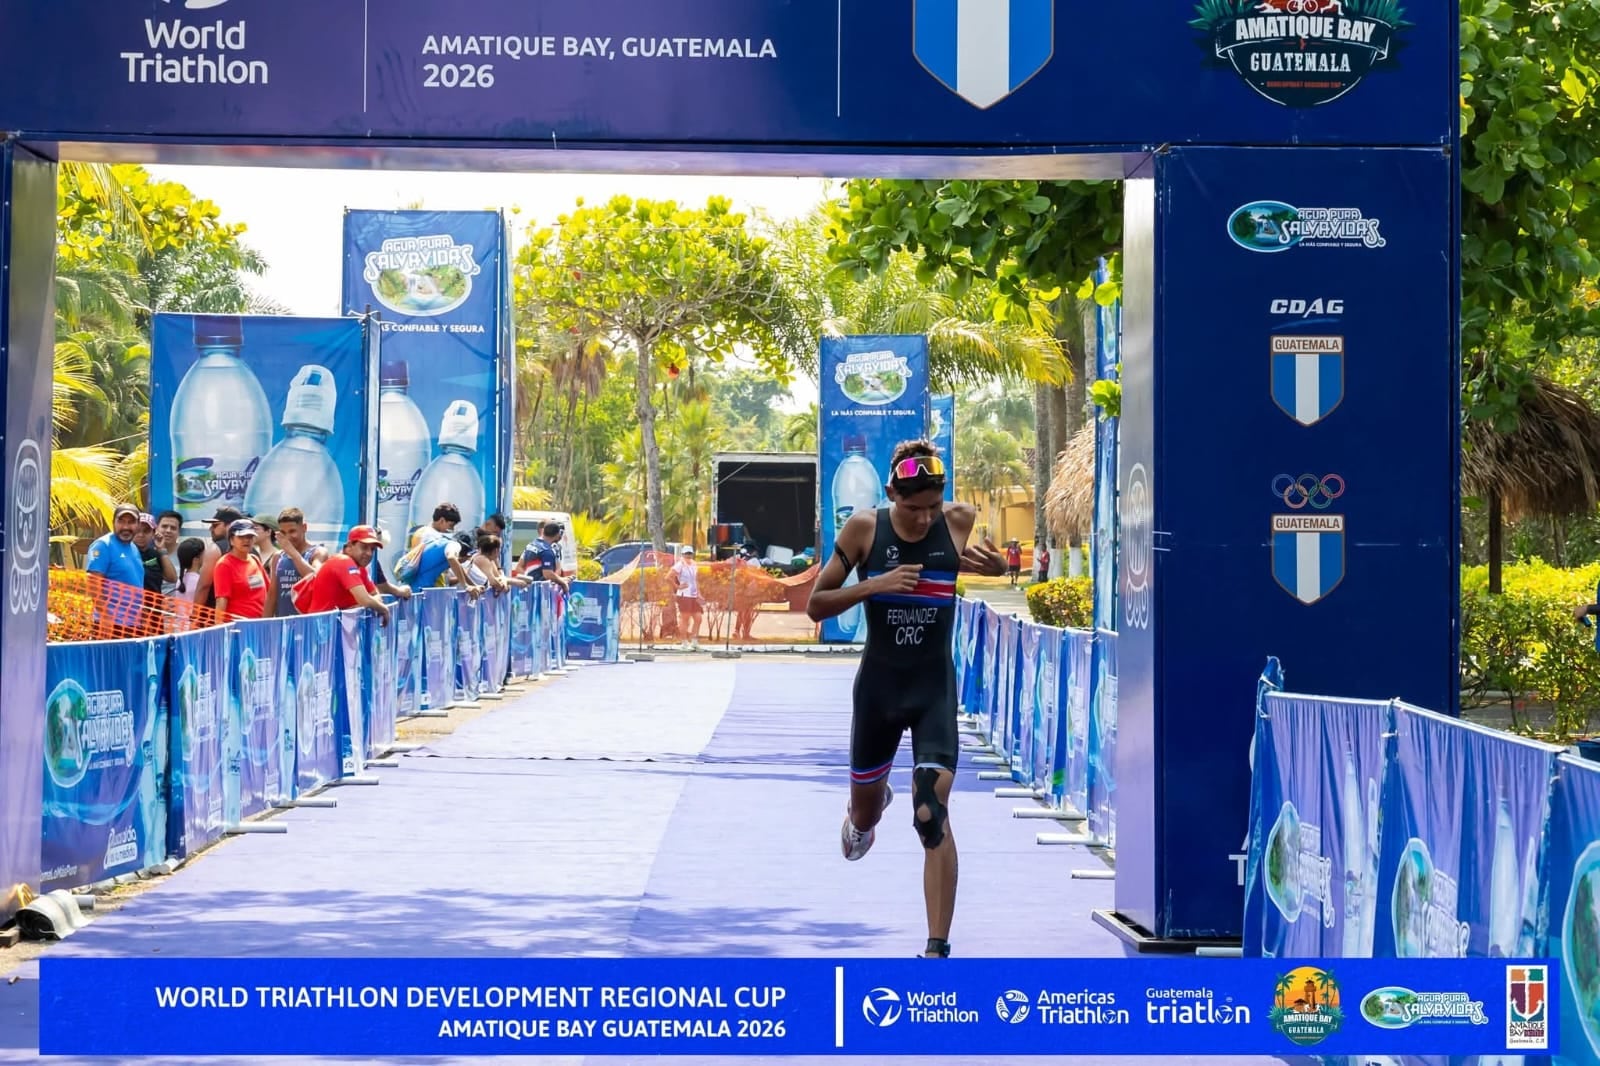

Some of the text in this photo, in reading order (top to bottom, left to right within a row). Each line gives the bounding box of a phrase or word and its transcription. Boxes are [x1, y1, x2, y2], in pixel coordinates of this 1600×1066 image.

[144, 18, 246, 50] World
[1235, 15, 1376, 43] AMATIQUE BAY
[421, 35, 778, 60] AMATIQUE BAY, GUATEMALA
[120, 52, 269, 84] Triathlon
[1250, 52, 1351, 72] GUATEMALA
[423, 64, 496, 88] 2026
[1298, 208, 1361, 220] AGUA PURA
[385, 236, 450, 251] AGUA PURA
[1279, 219, 1380, 247] SALVAVIDAS
[364, 246, 474, 282] SALVAVIDAS
[1270, 297, 1344, 319] CDAG
[391, 324, 439, 332] CONFIABLE
[442, 324, 448, 332] Y
[449, 325, 485, 333] SEGURA
[1274, 338, 1340, 351] GUATEMALA
[1275, 517, 1341, 530] GUATEMALA
[887, 608, 939, 625] FERNANDEZ
[895, 626, 925, 645] CRC
